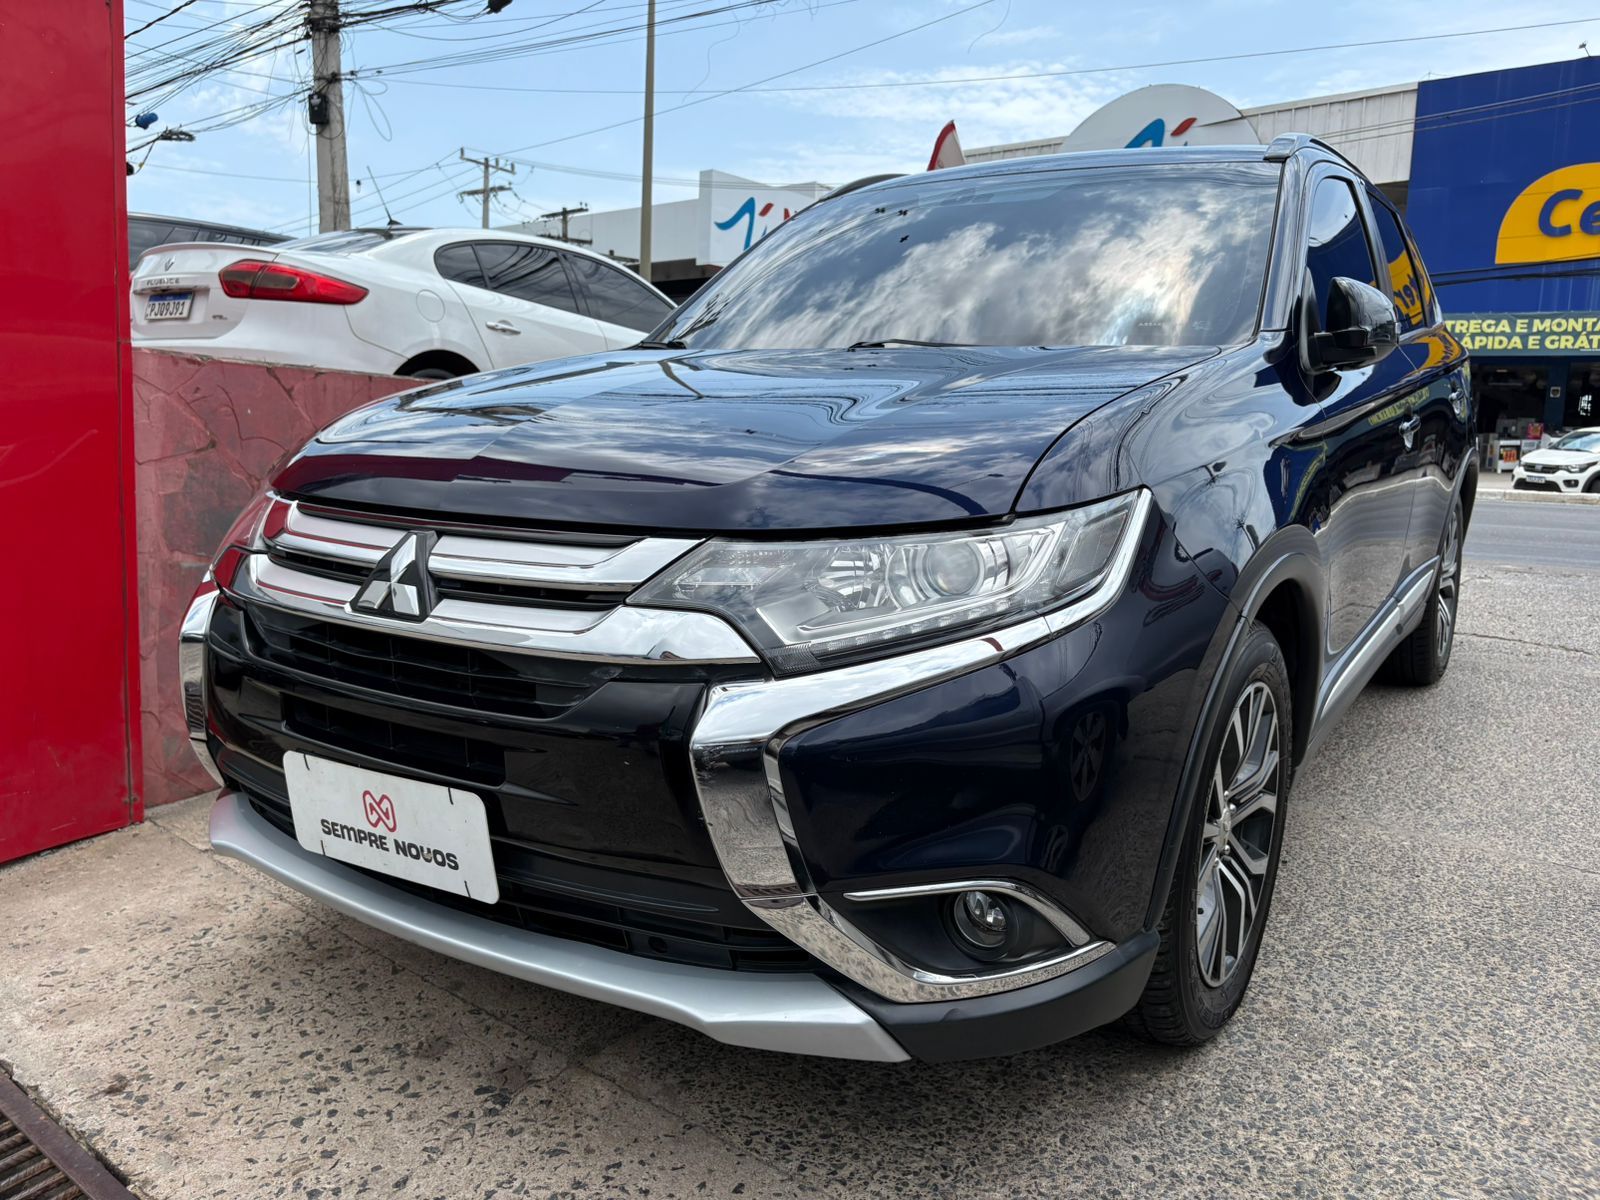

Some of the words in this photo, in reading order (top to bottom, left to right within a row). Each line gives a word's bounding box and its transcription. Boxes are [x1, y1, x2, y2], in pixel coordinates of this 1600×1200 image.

[1515, 318, 1529, 334] E
[1527, 335, 1542, 350] E
[320, 818, 390, 852] SEMPRE
